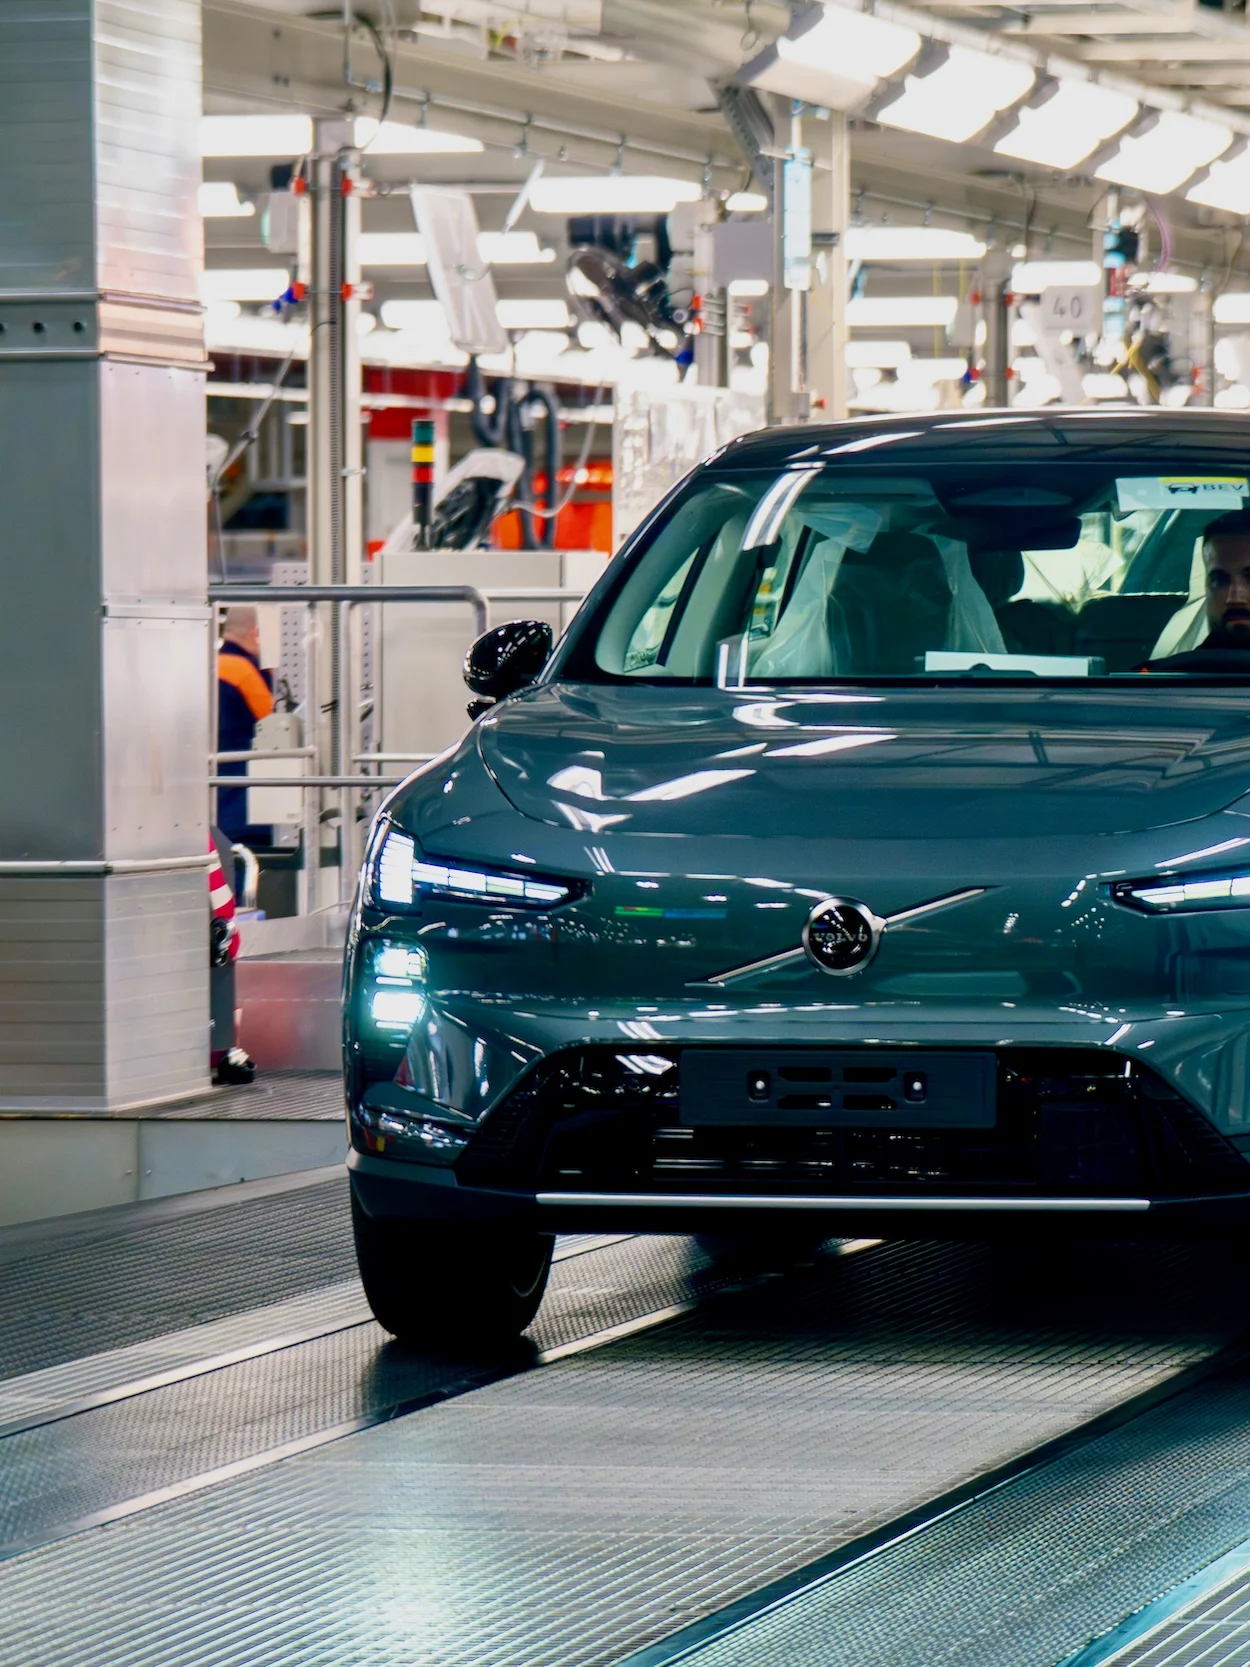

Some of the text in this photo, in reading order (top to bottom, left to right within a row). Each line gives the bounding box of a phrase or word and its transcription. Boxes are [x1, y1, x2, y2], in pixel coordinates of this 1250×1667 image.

[1052, 295, 1082, 319] 40
[1202, 483, 1243, 491] BEV
[812, 932, 869, 943] VOLVO
